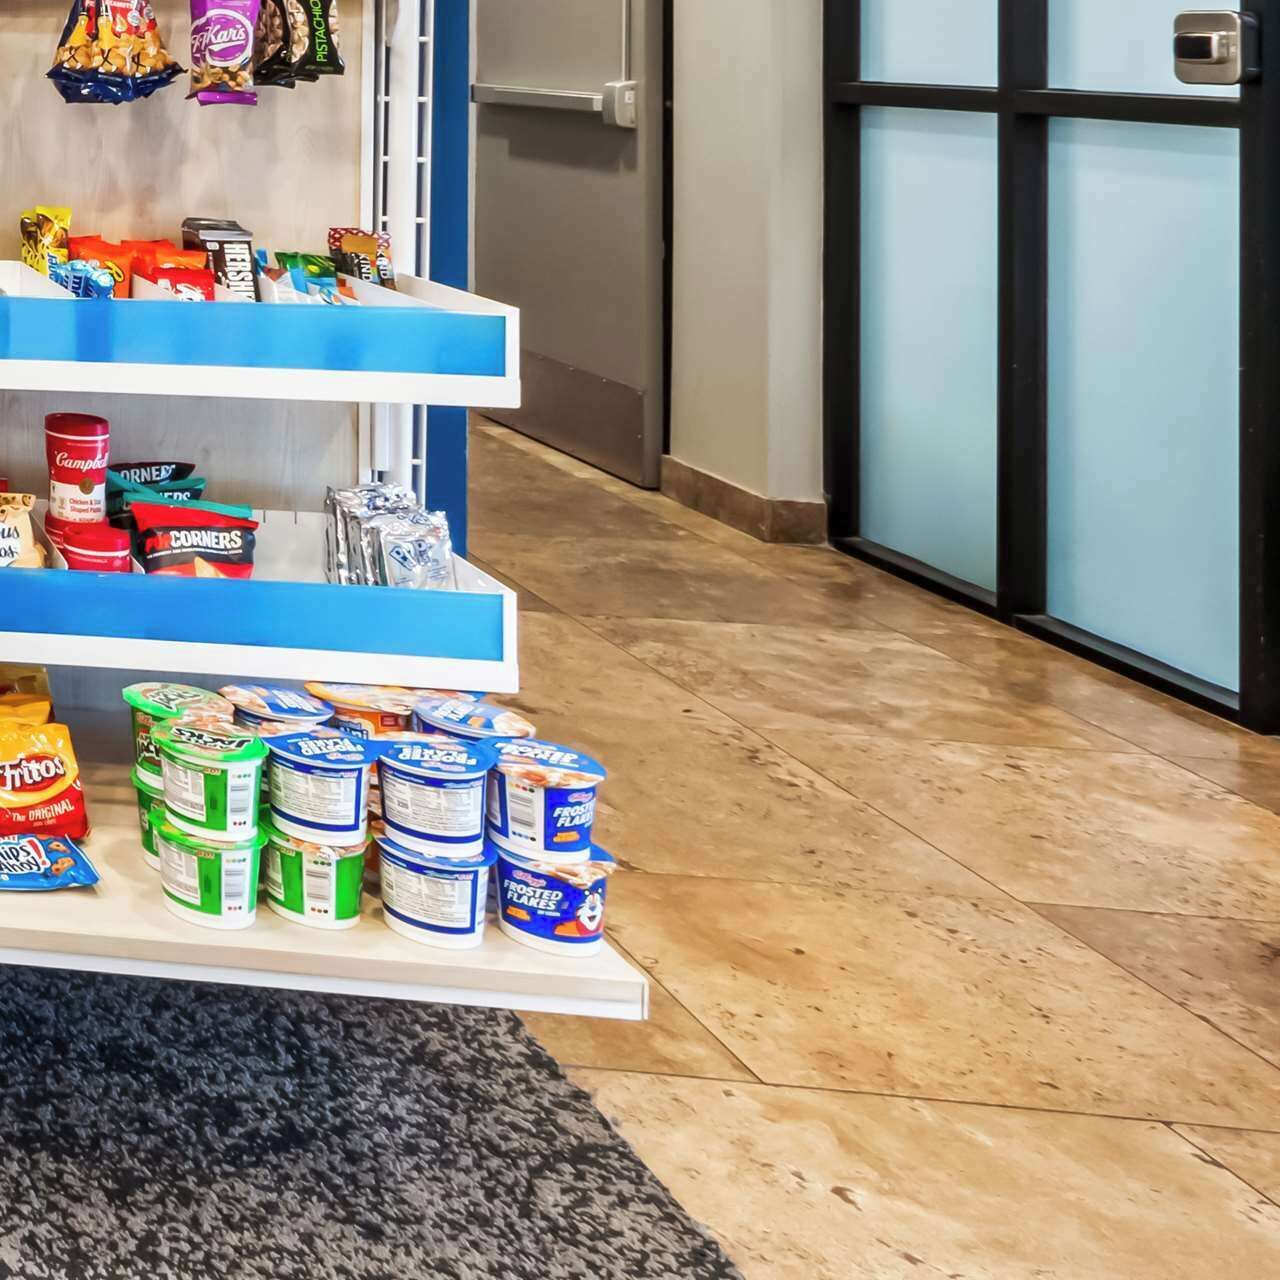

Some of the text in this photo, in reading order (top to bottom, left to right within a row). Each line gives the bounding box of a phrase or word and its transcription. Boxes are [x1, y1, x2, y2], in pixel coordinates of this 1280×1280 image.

[206, 22, 246, 43] Kar's
[359, 252, 373, 282] KIND
[12, 799, 76, 823] The ORIGINAL
[503, 879, 563, 901] FROSTED
[507, 889, 557, 911] FLAKES
